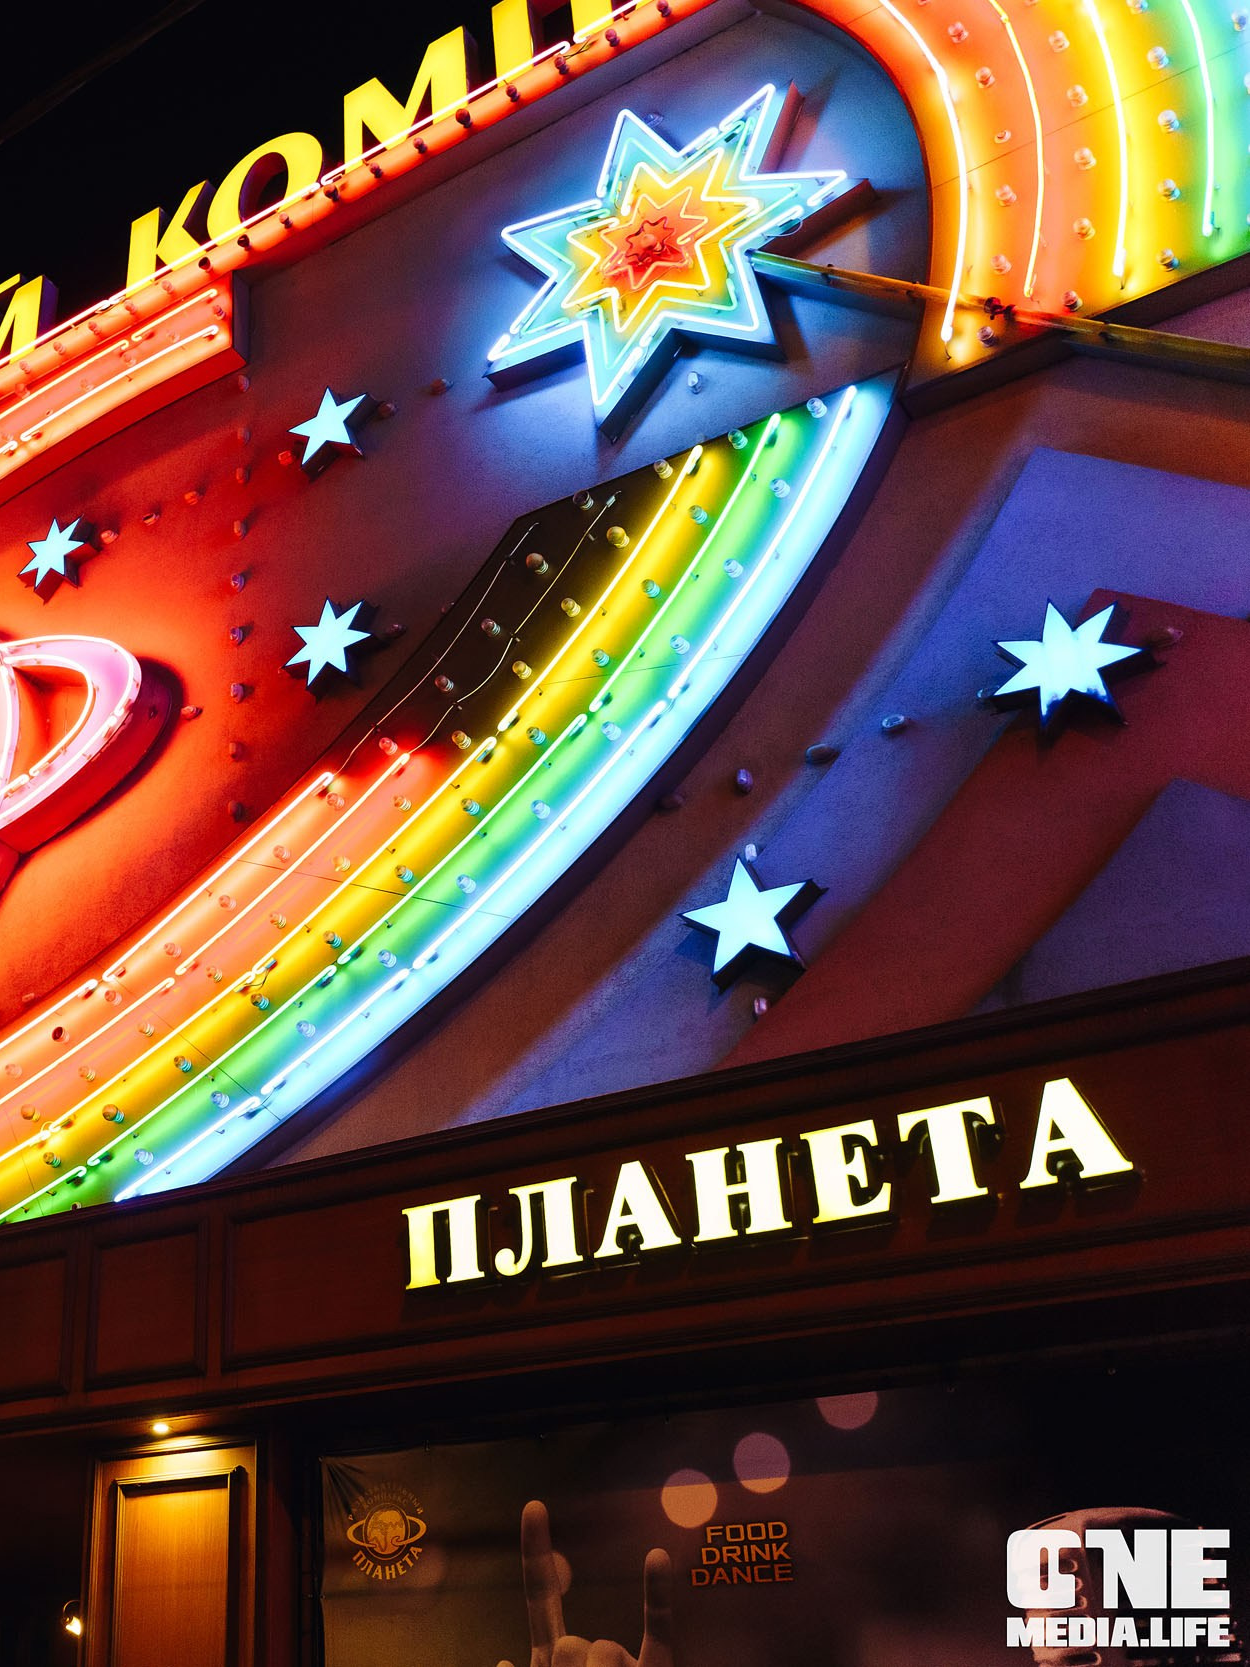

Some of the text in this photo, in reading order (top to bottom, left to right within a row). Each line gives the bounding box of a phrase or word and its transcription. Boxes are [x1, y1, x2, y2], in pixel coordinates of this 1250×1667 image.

[125, 0, 640, 293] КОМП
[402, 1077, 1134, 1290] ПЛАНЕТА
[706, 1521, 788, 1544] FOOD
[352, 1546, 423, 1580] ПЛАНЕТА
[701, 1541, 791, 1565] DRINK
[691, 1563, 794, 1587] DANCE
